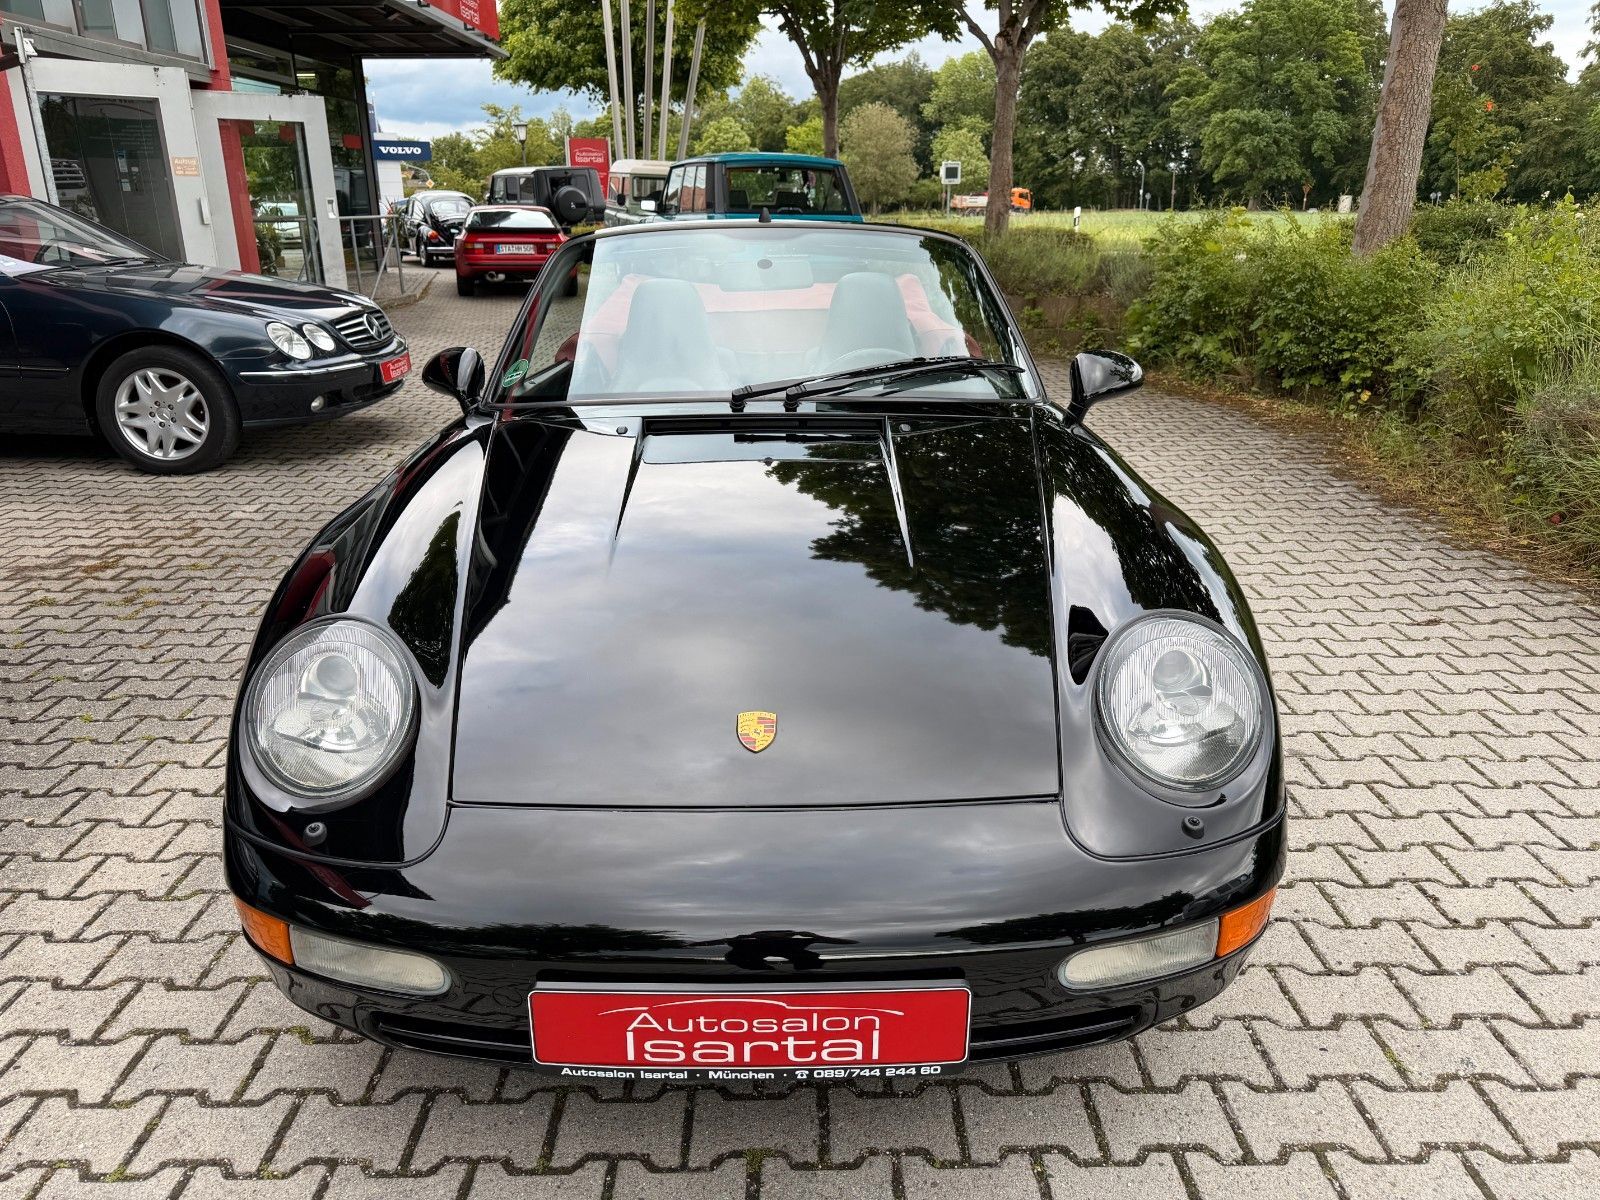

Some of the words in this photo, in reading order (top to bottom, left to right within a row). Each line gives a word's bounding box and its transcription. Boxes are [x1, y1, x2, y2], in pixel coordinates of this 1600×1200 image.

[378, 146, 422, 155] VOLVO
[575, 154, 604, 163] Isartal
[626, 1012, 880, 1033] Autosalon
[626, 1030, 880, 1062] Isartal
[561, 1067, 635, 1079] Autosalon
[640, 1070, 688, 1079] Isartal
[708, 1070, 775, 1079] München
[813, 1068, 881, 1078] 089/744
[885, 1067, 917, 1077] 244
[920, 1066, 942, 1074] 60
